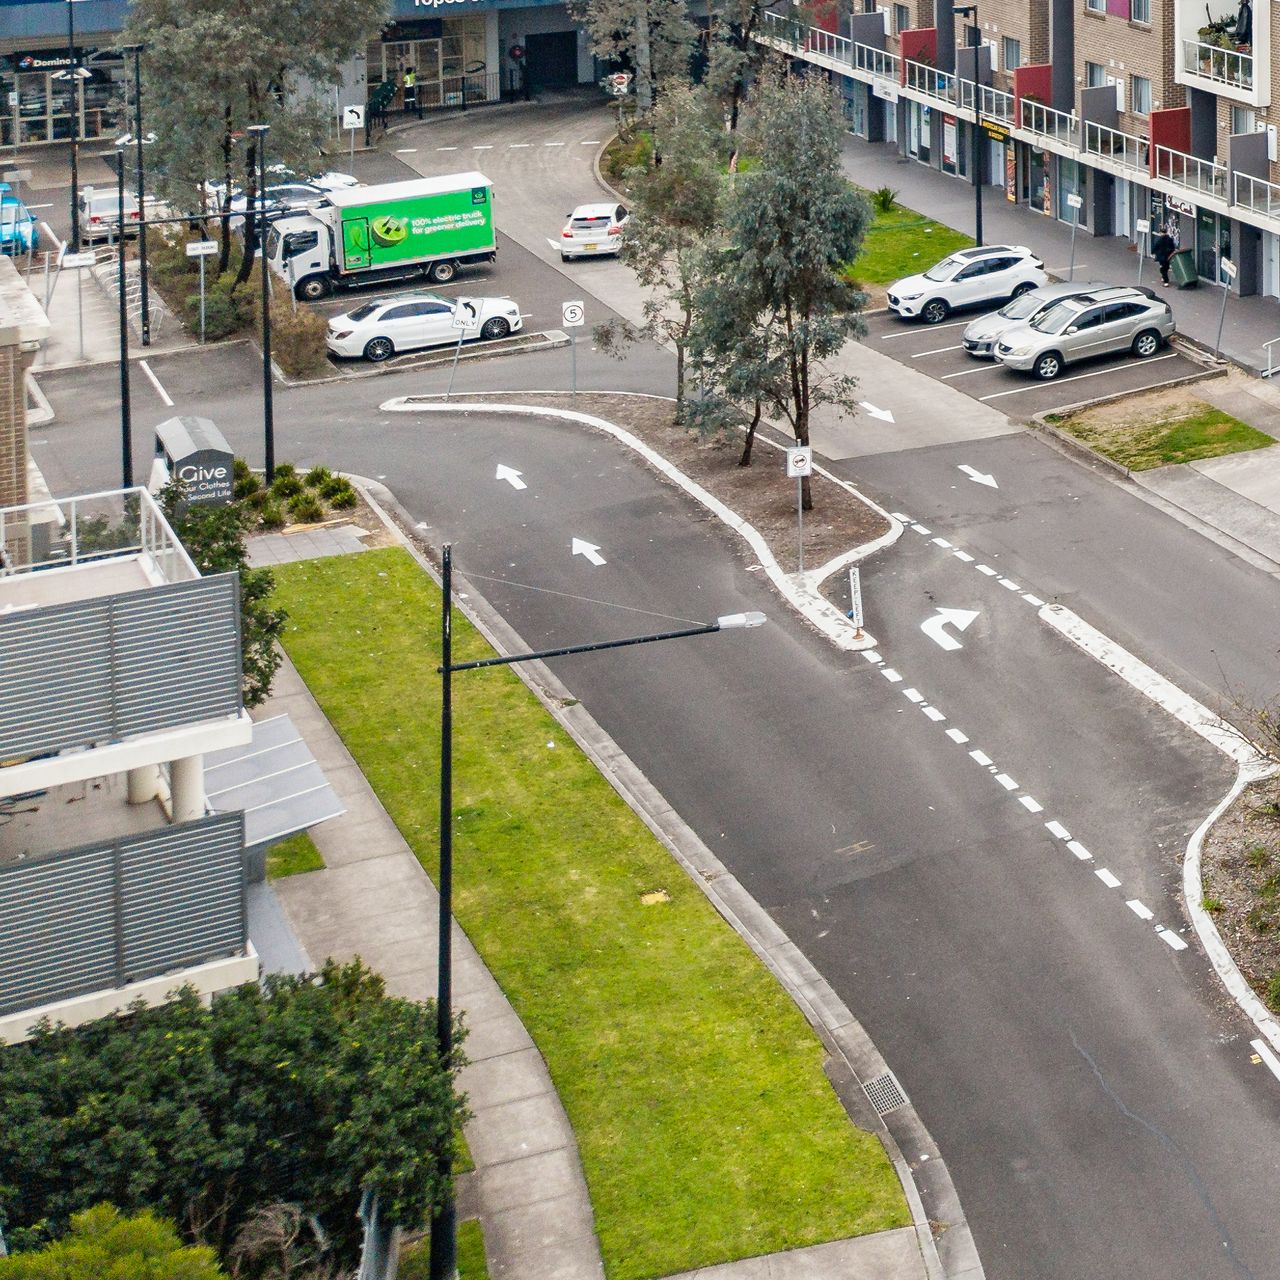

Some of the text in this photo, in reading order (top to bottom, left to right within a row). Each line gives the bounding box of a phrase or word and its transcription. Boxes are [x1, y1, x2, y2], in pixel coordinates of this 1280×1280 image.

[33, 57, 77, 67] Dominos
[412, 210, 483, 227] 100% electric truck
[412, 218, 486, 234] for greener delivery
[569, 309, 577, 319] 5
[179, 465, 227, 483] Give
[199, 480, 230, 491] Clothes
[187, 489, 232, 501] Second Life
